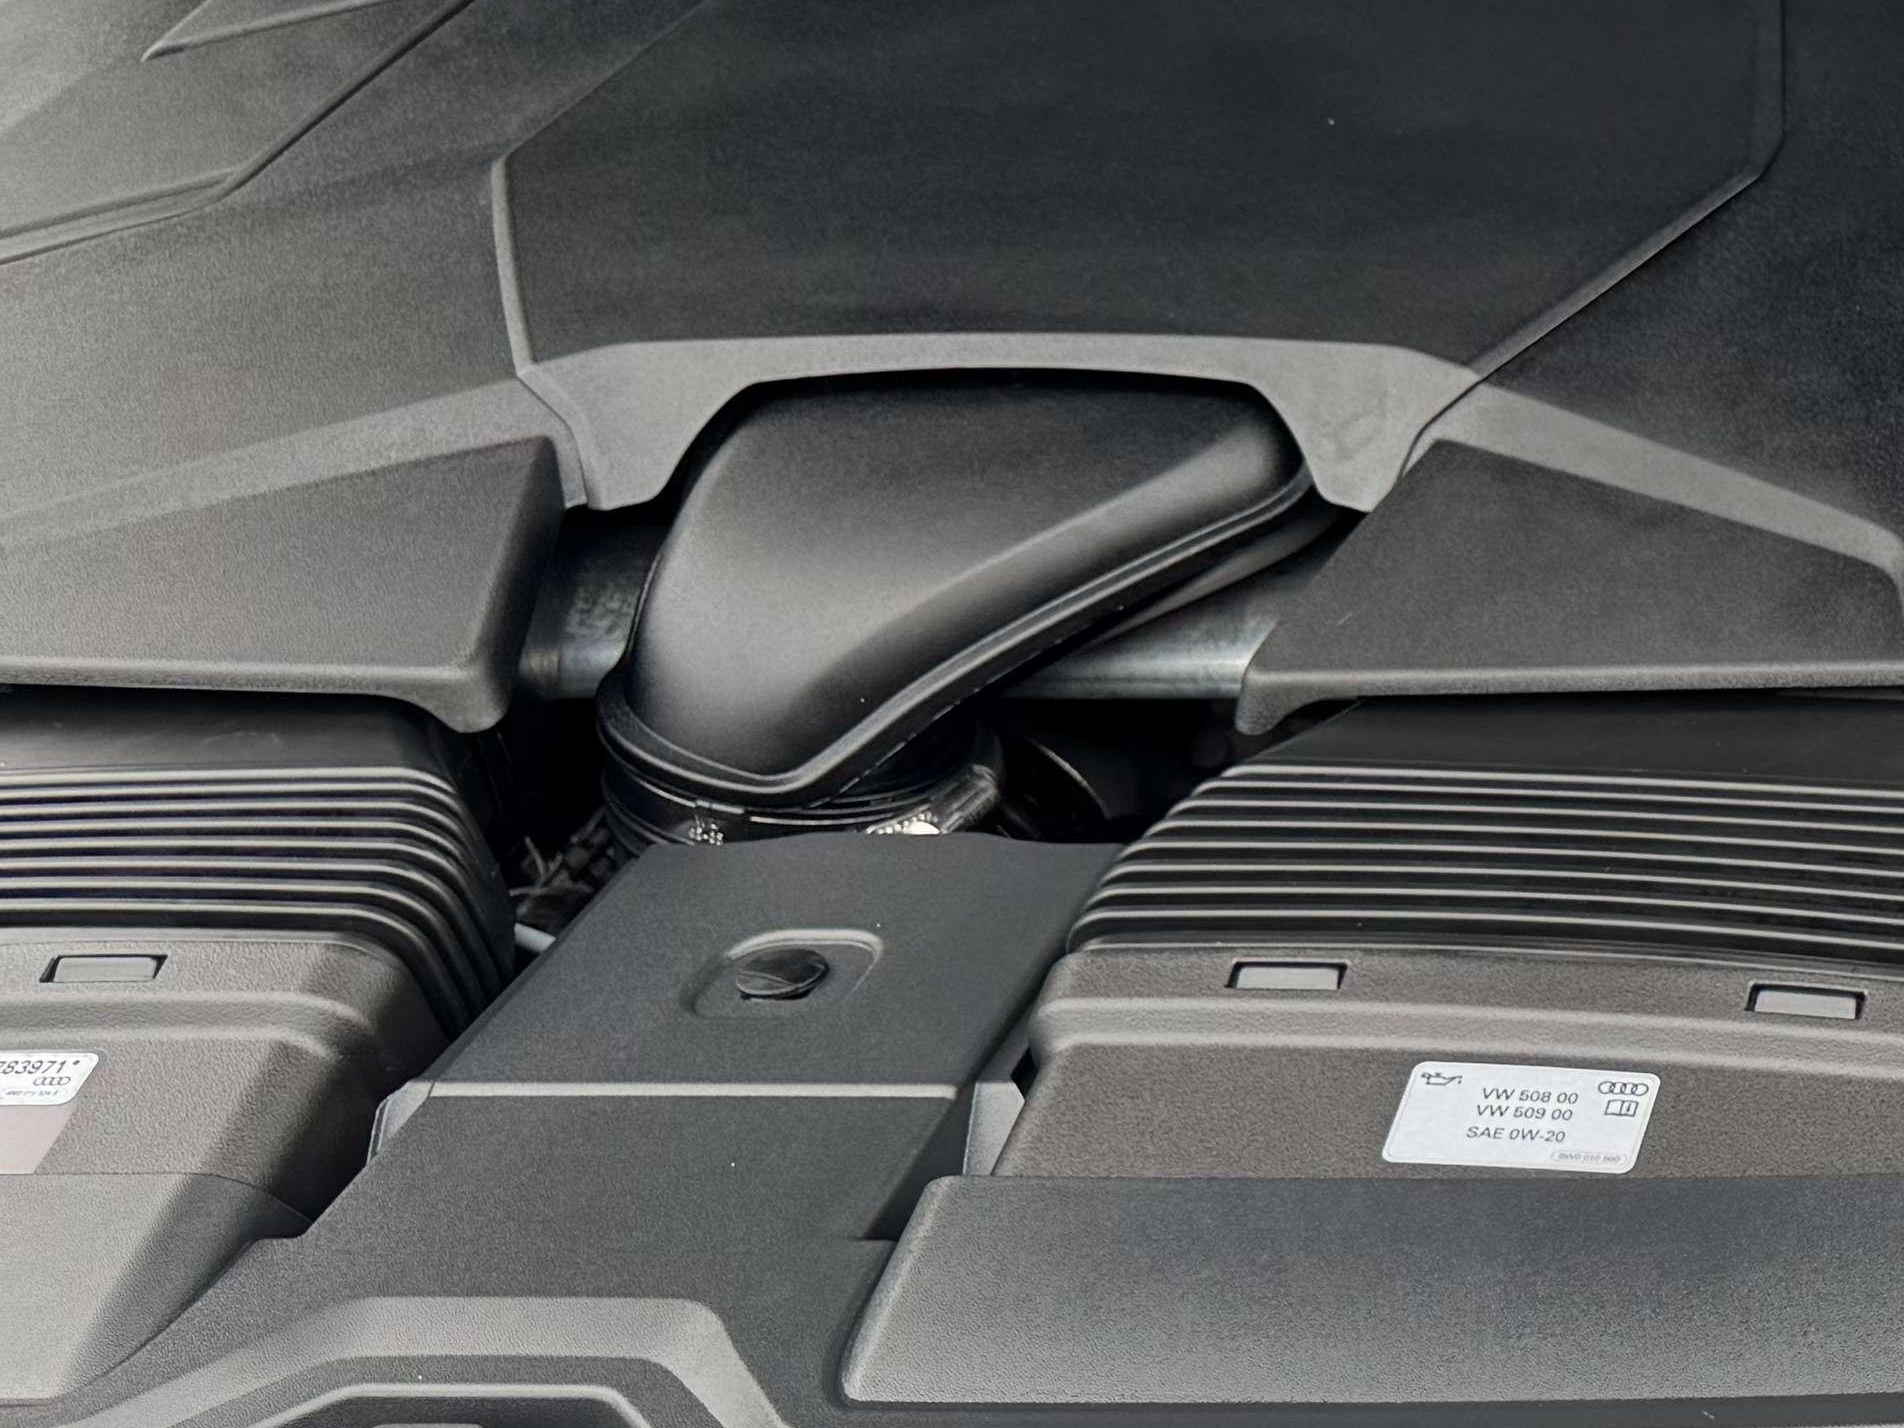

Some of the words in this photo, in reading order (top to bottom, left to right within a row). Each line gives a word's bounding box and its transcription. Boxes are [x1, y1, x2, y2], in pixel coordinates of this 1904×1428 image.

[1482, 1087, 1515, 1101] VW
[1518, 1089, 1551, 1104] 508
[1556, 1092, 1579, 1105] 00
[1476, 1104, 1510, 1117] VW
[1513, 1106, 1546, 1120] 509
[1551, 1109, 1573, 1121] 00
[1466, 1126, 1506, 1140] SAE
[1509, 1128, 1566, 1143] 0W-20
